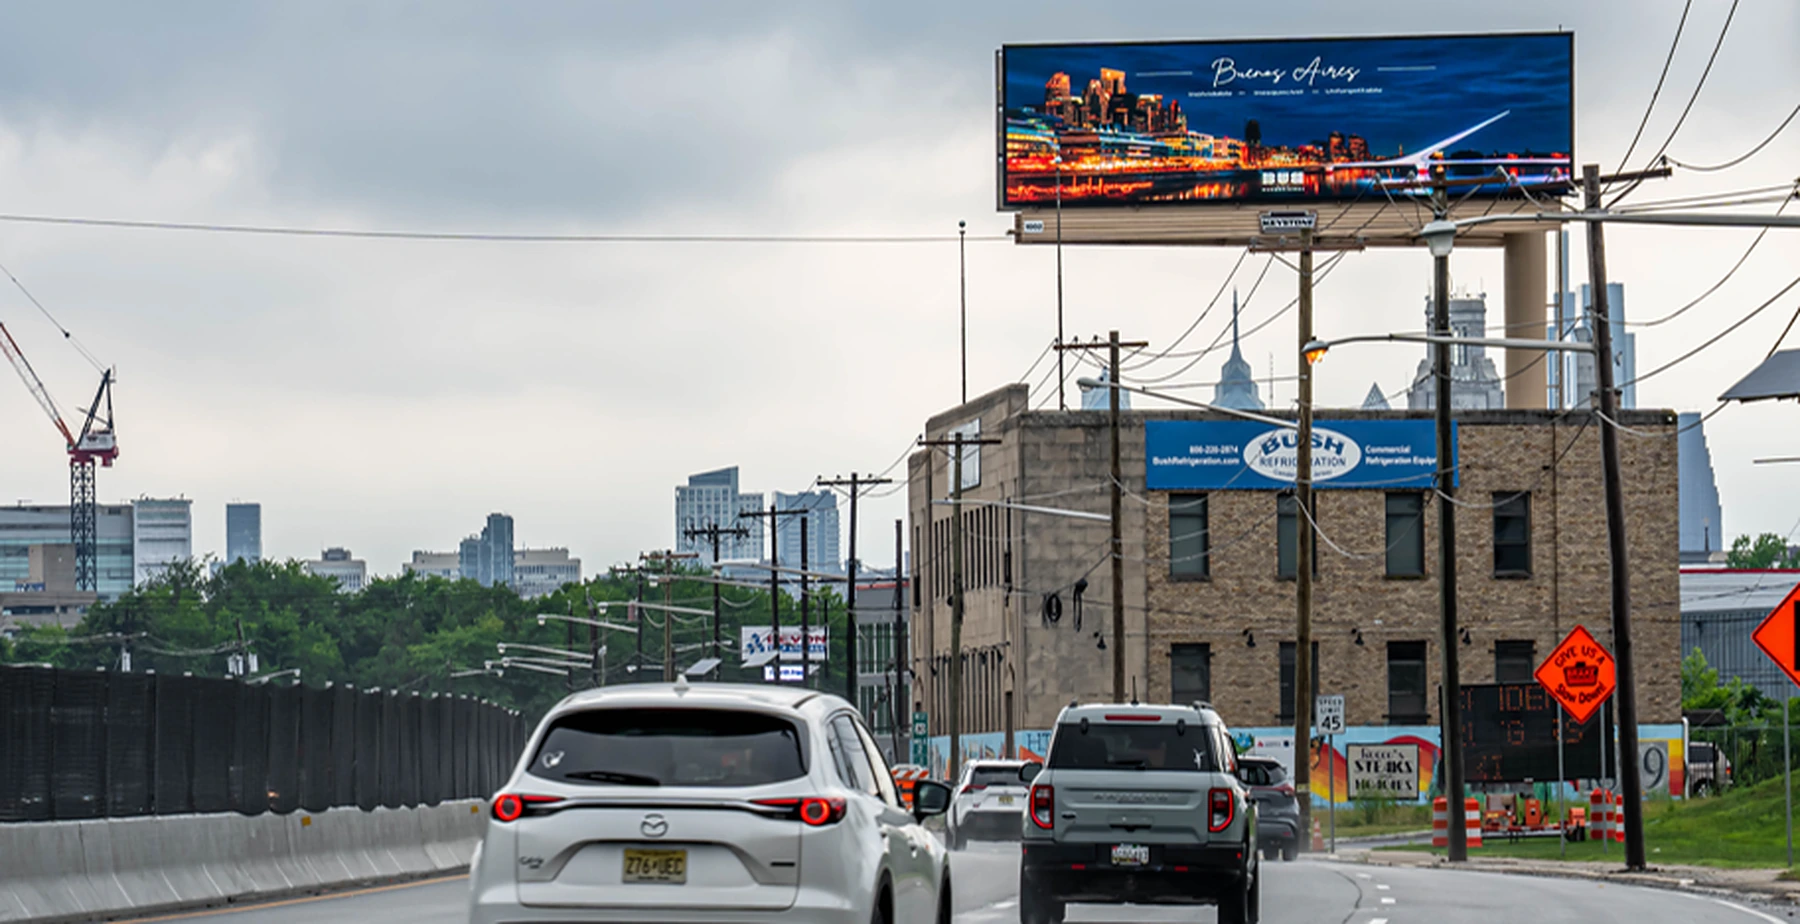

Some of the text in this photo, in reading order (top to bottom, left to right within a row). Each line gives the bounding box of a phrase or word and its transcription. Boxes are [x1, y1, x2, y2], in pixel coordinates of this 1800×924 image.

[1211, 56, 1360, 88] Buenos Aires
[1262, 218, 1313, 227] KEYSTONE
[1260, 432, 1344, 456] BUSH
[1365, 444, 1411, 454] Commercial
[1365, 456, 1411, 467] Refrigeration
[1554, 645, 1578, 667] GIVE
[1581, 645, 1598, 658] US
[1321, 715, 1341, 730] 45
[1354, 760, 1413, 773] STEAKS
